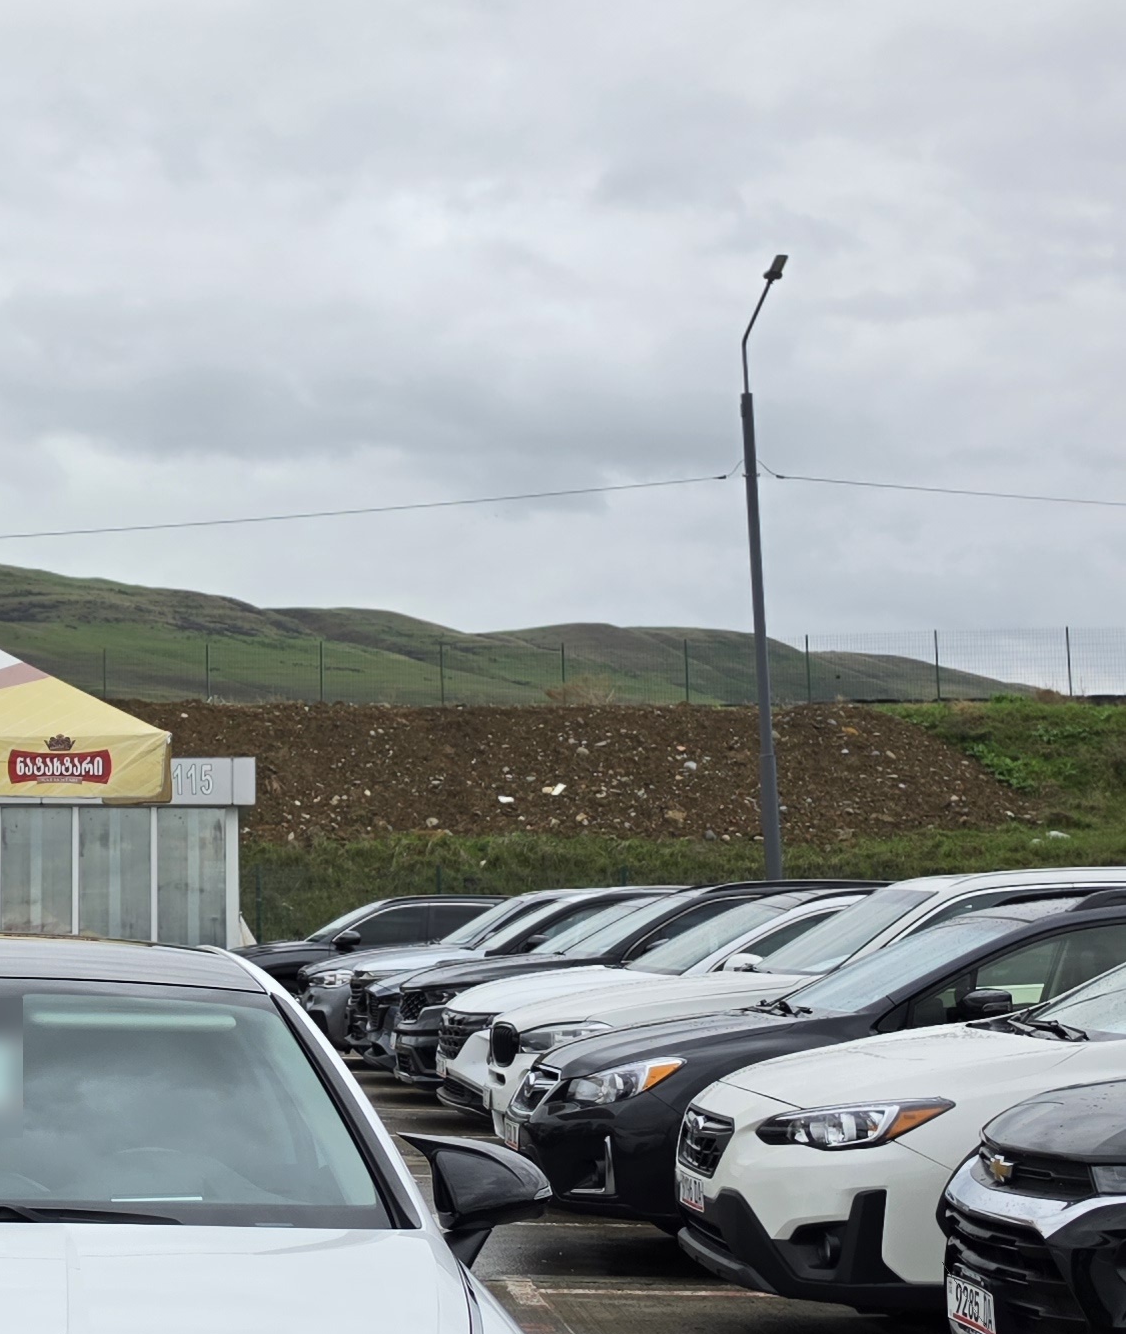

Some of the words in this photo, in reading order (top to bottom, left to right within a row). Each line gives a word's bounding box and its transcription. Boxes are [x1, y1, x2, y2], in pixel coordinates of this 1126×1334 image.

[16, 756, 103, 776] ნატახტარი
[173, 764, 213, 795] 115
[956, 1283, 980, 1322] 9285
[983, 1294, 994, 1331] DA
